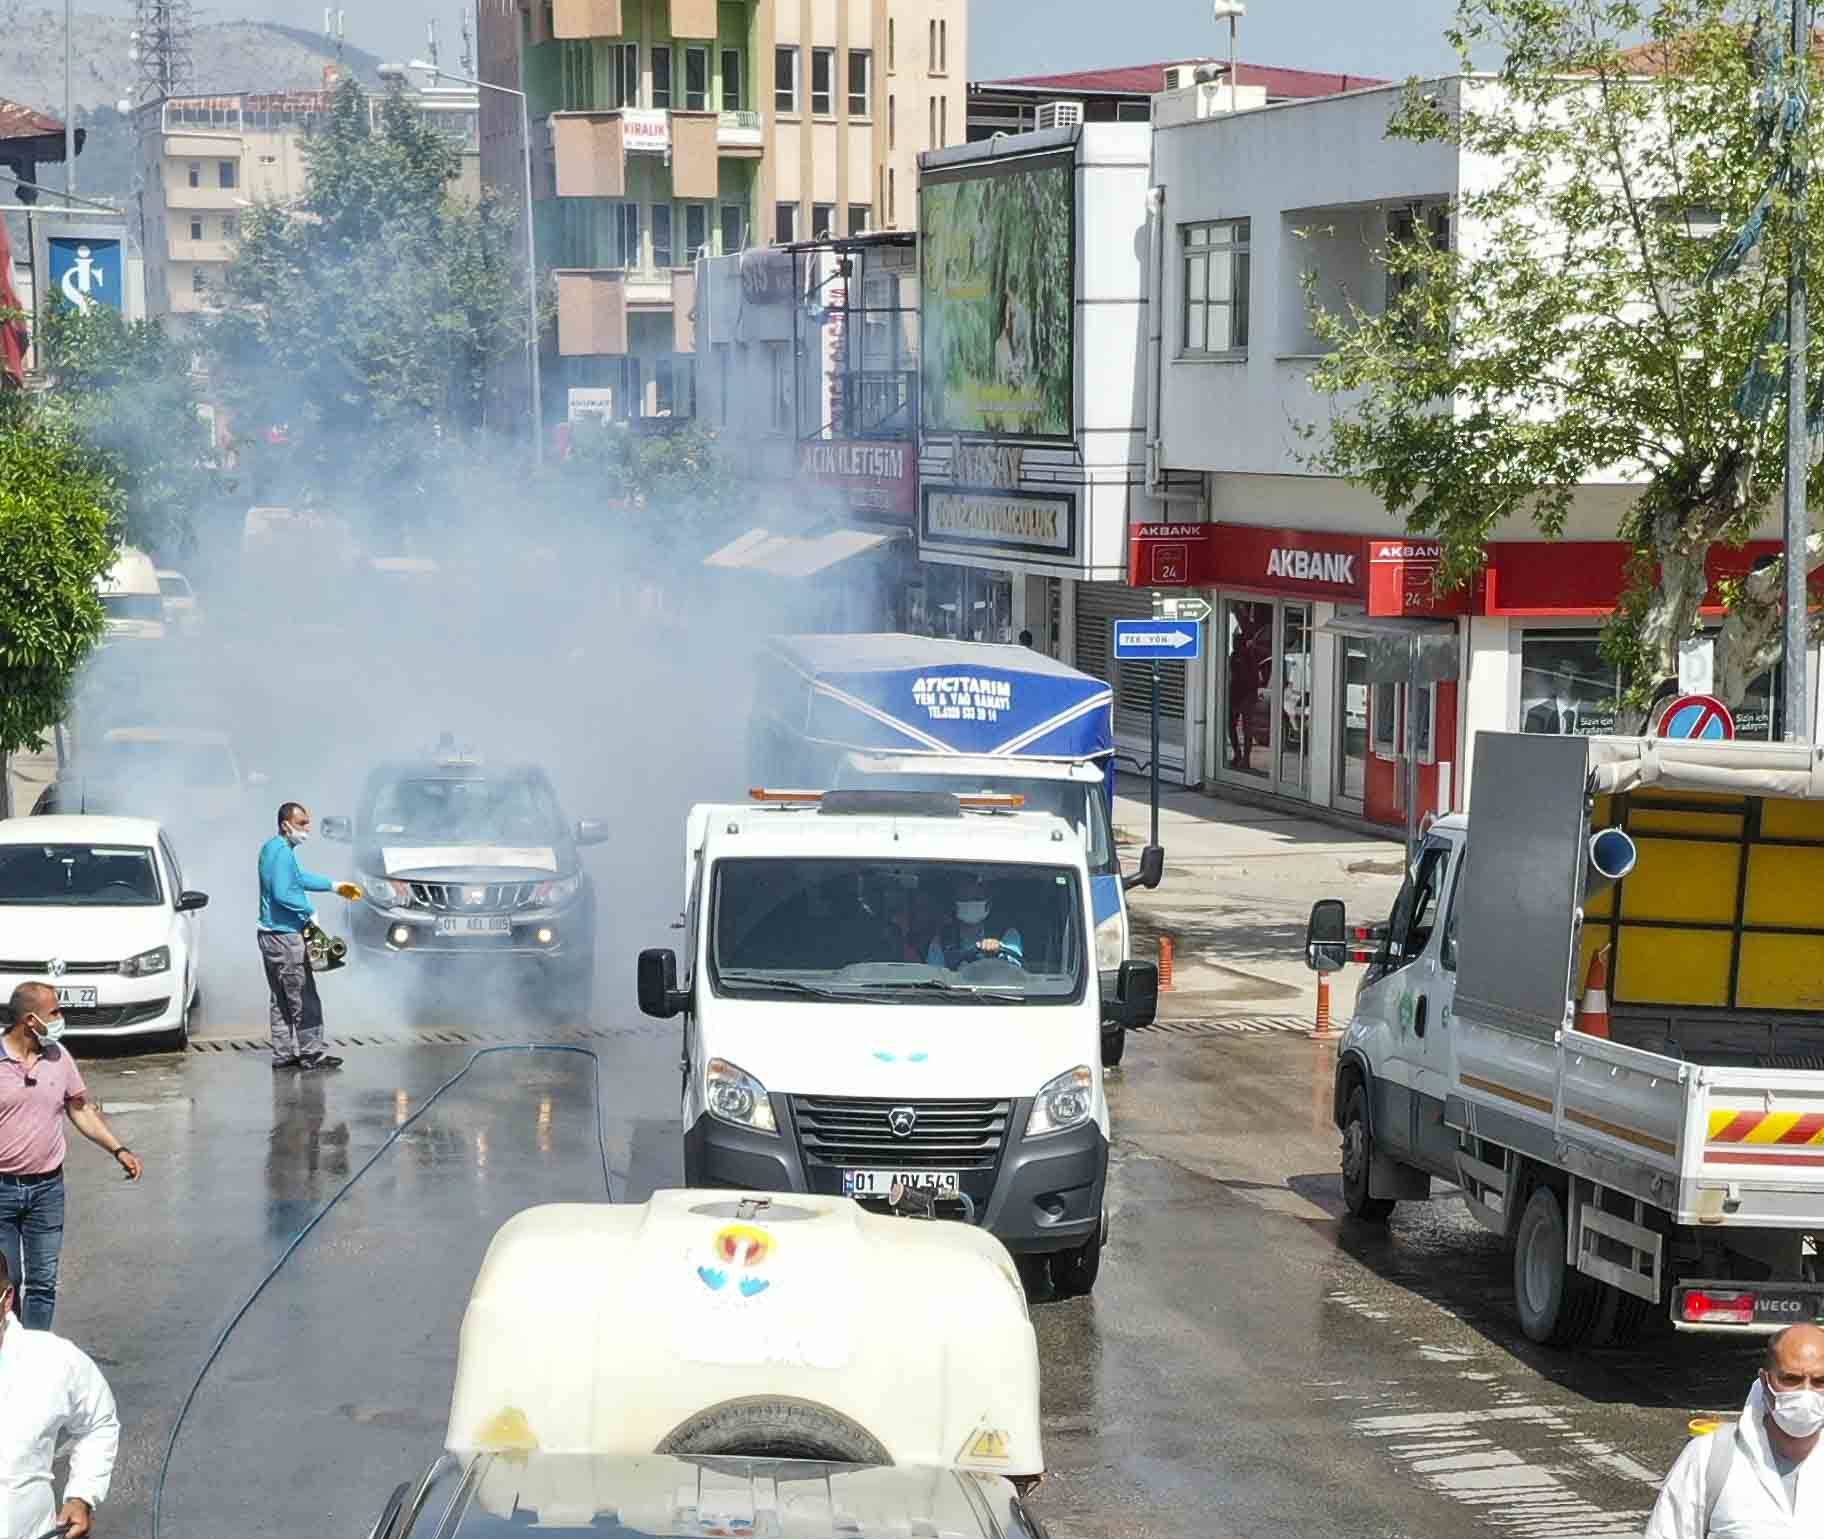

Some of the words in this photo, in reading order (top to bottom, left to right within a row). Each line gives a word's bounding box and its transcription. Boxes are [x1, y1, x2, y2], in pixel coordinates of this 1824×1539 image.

[1138, 525, 1201, 537] AKBANK
[1378, 546, 1448, 559] AKBAN
[1162, 565, 1177, 579] 24
[1266, 548, 1357, 585] AKBANK
[1406, 594, 1421, 607] 24
[856, 1173, 875, 1191] 01
[1755, 1299, 1801, 1312] IVECO
